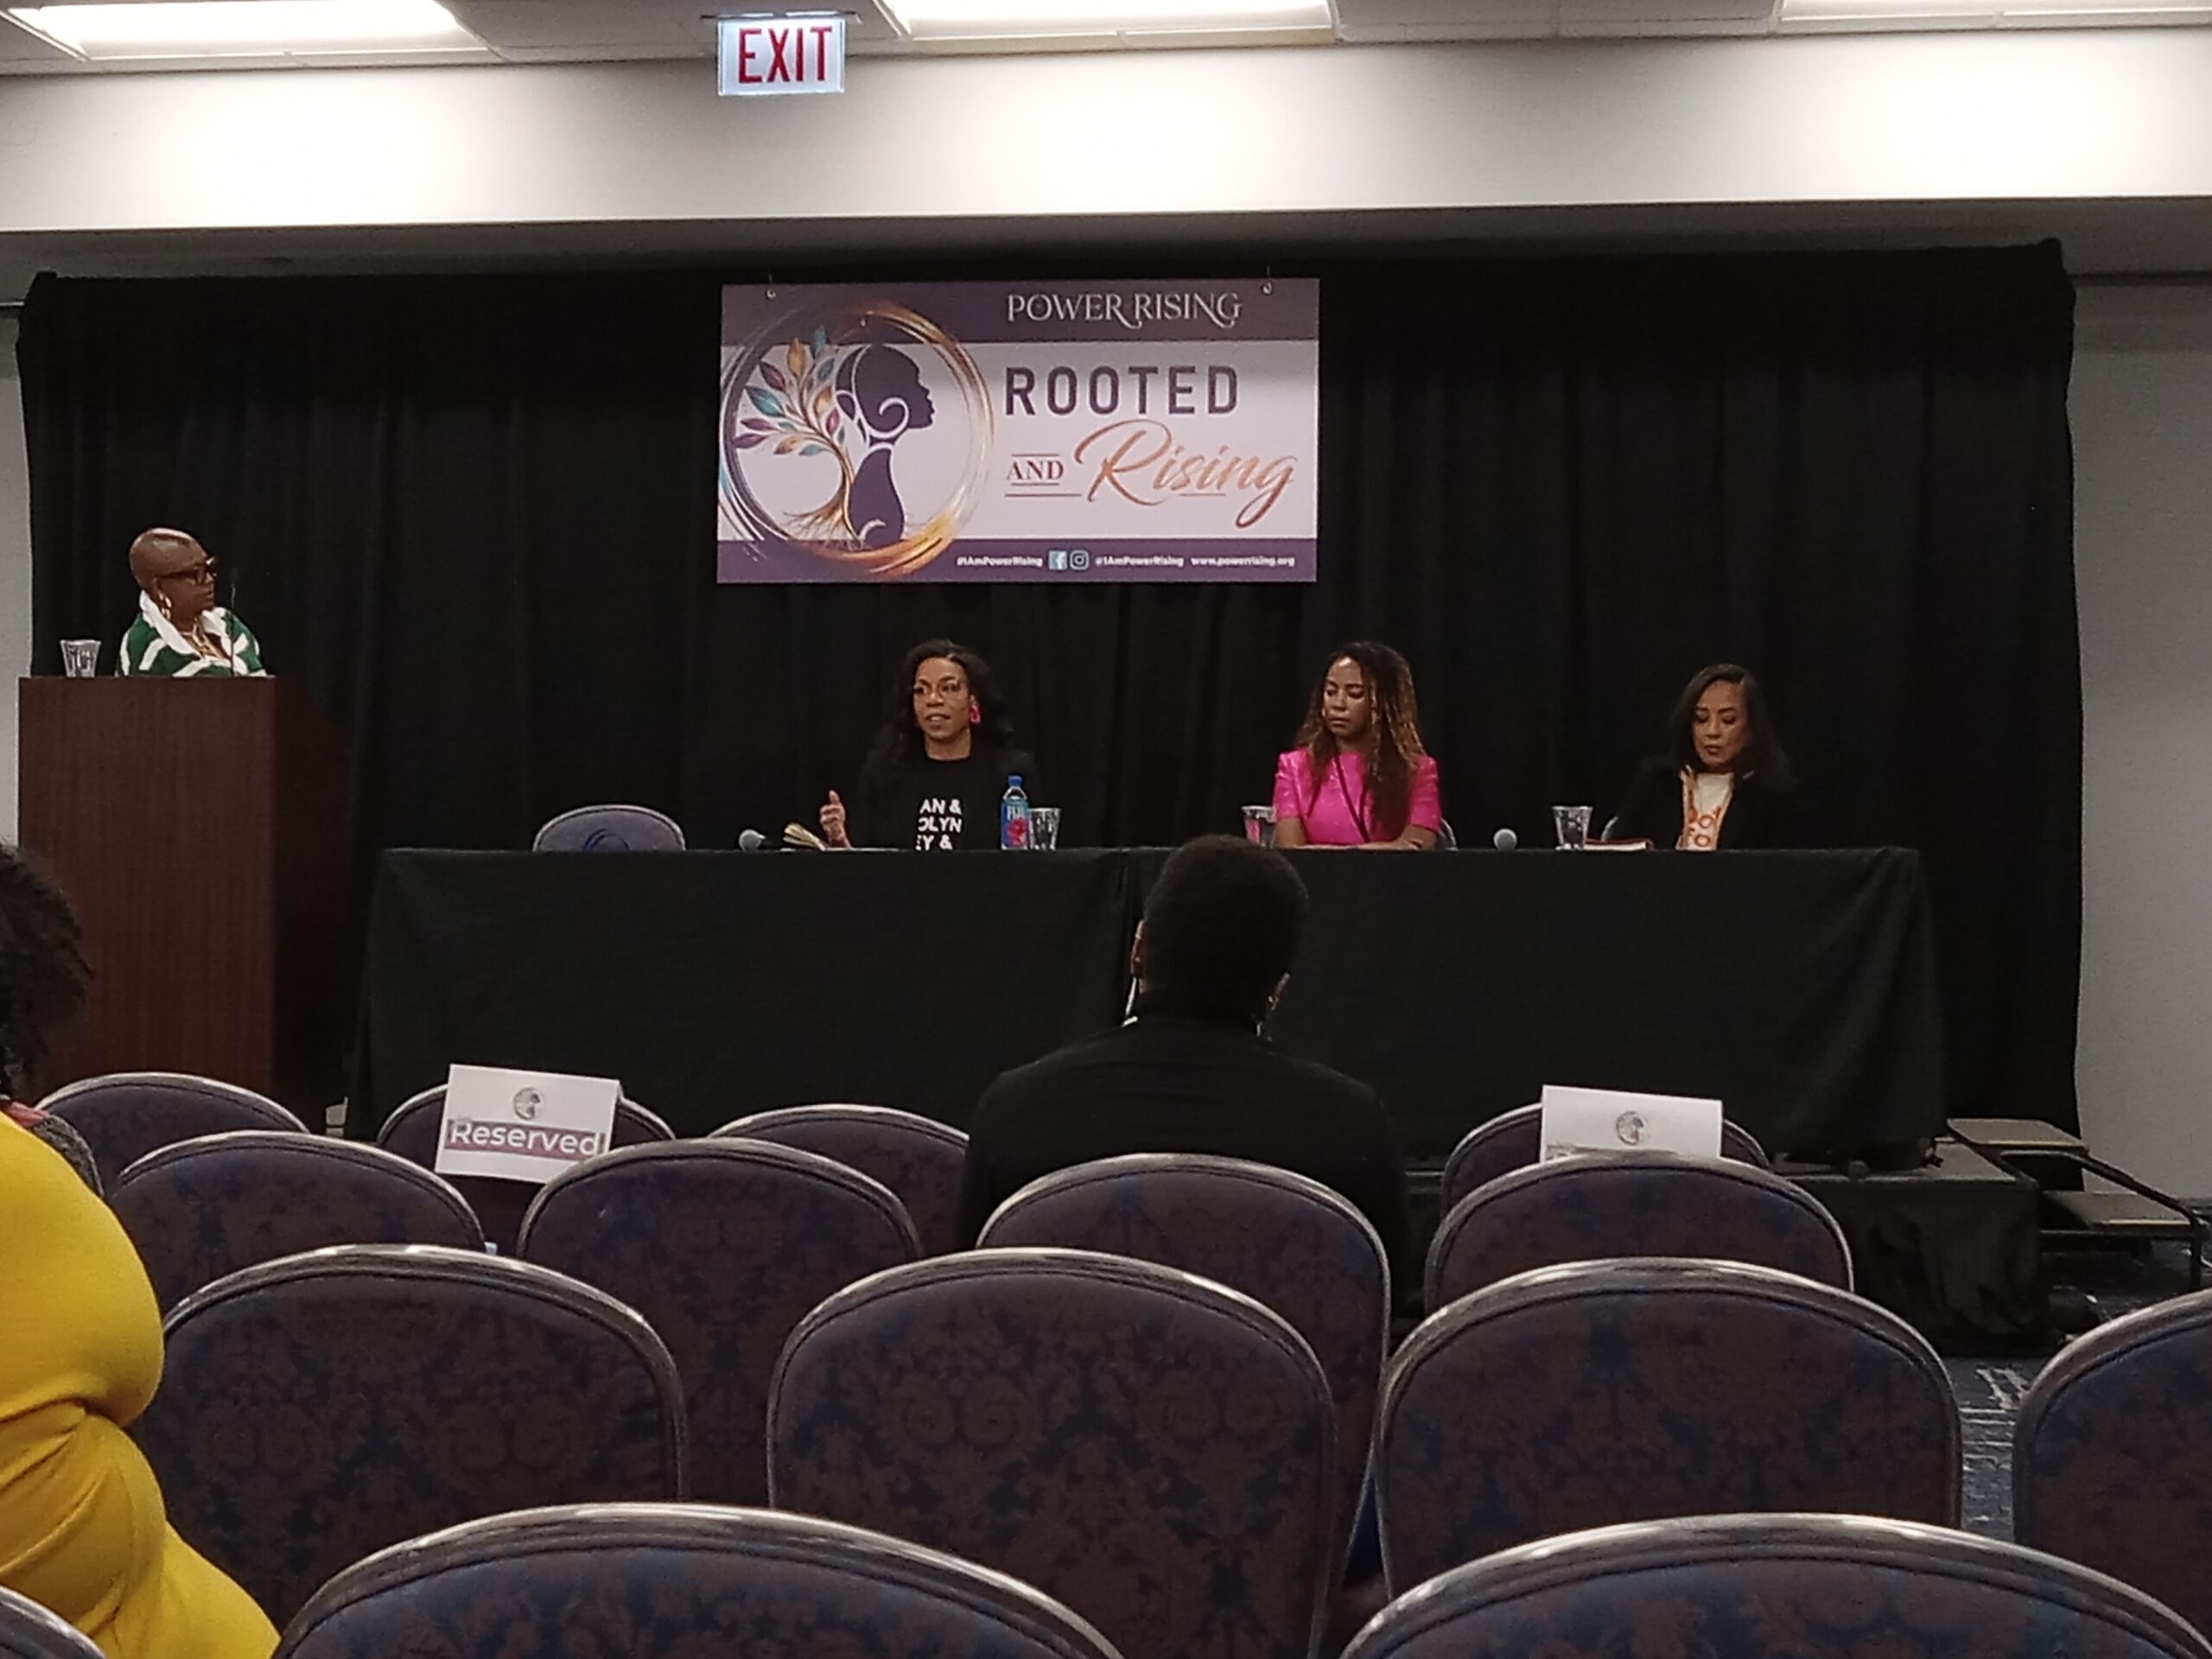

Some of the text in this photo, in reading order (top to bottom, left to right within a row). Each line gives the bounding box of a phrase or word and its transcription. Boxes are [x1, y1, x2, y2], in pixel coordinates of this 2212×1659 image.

[738, 26, 832, 83] EXIT
[1007, 292, 1243, 329] POWER RISING
[1005, 365, 1238, 416] ROOTED
[1006, 418, 1299, 529] AND Rising
[449, 1118, 601, 1157] Reserved
